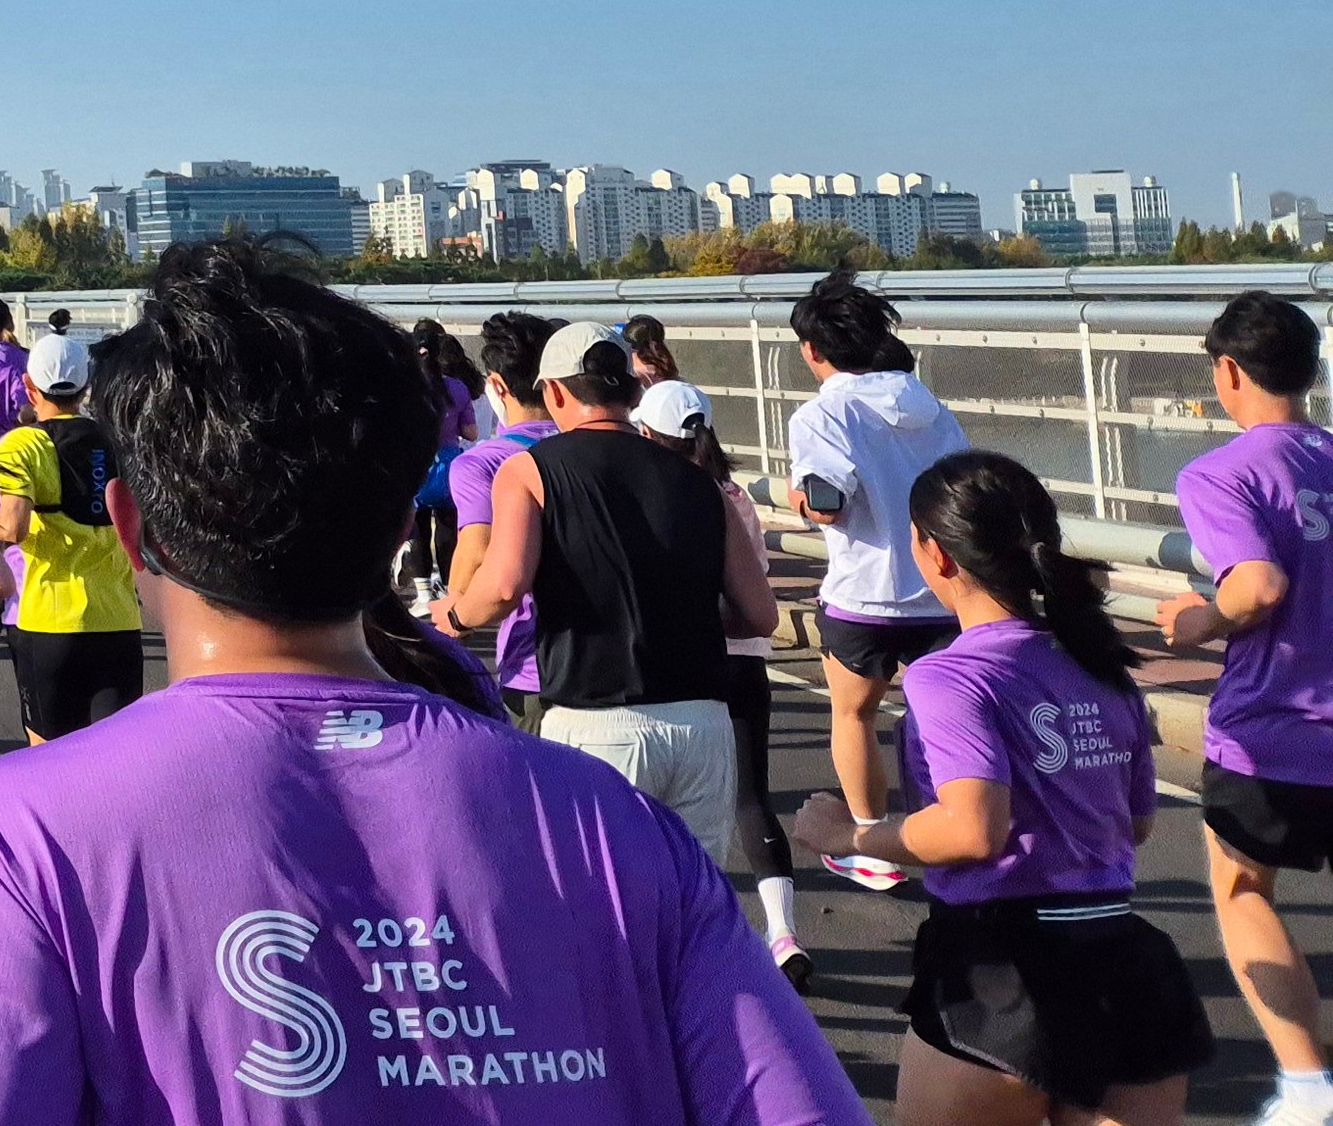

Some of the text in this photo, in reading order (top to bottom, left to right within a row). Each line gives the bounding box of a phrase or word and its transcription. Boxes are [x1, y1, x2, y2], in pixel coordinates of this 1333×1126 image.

[1068, 702, 1100, 717] 2024
[1071, 719, 1103, 734] JTBC
[1073, 736, 1113, 752] SEOUL
[1074, 751, 1132, 770] MARATHO
[352, 915, 455, 948] 2024
[362, 960, 468, 993] JTBC
[368, 1005, 515, 1040] SEOUL
[377, 1047, 606, 1087] MARATHON
